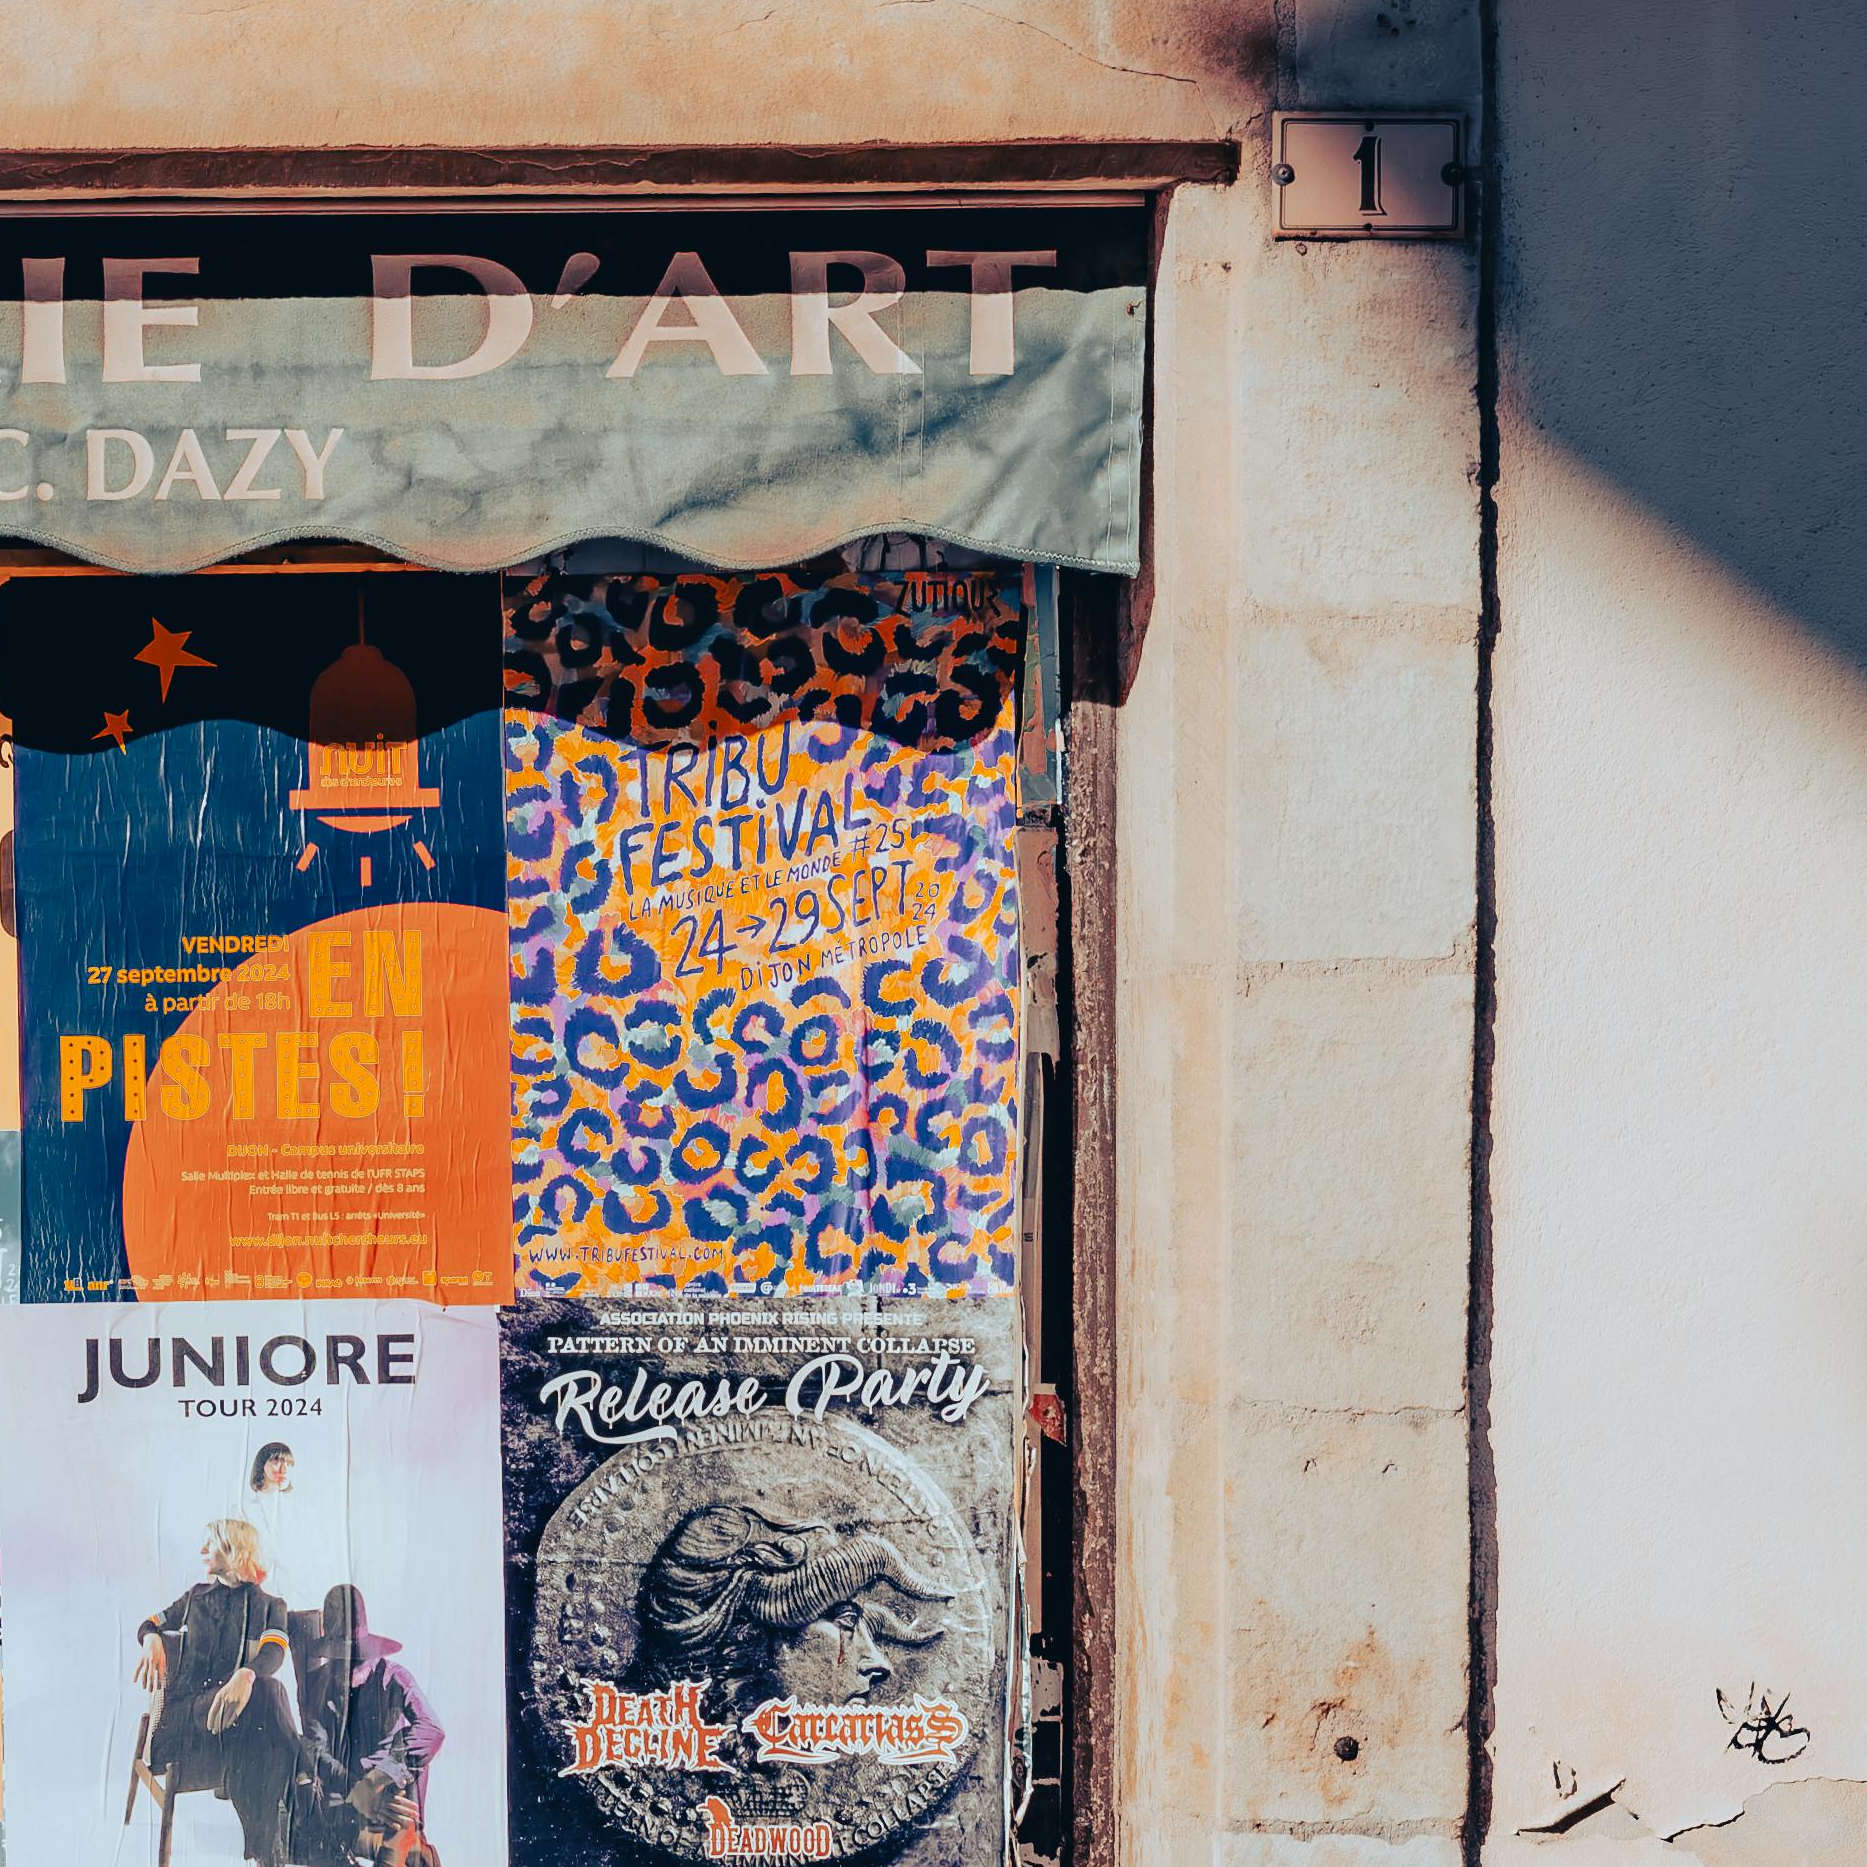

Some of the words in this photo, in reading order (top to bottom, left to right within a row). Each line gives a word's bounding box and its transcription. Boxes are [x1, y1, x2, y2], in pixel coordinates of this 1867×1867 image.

[1354, 135, 1386, 217] 1
[370, 249, 1057, 382] D'ART
[87, 427, 344, 501] DAZY
[848, 818, 906, 862] #25
[629, 898, 652, 921] LA
[740, 872, 762, 896] ET
[765, 869, 784, 890] LE
[786, 851, 842, 887] MONDE
[670, 909, 735, 978] 24
[768, 890, 821, 953] 29
[827, 859, 914, 934] SEPT
[181, 935, 290, 954] VENDREDI
[821, 924, 927, 966] MÉTROPOLE
[87, 966, 113, 985] 27
[117, 964, 231, 987] septembre
[237, 964, 291, 982] 2024
[308, 929, 423, 1018] EN
[145, 993, 158, 1012] à
[162, 992, 220, 1014] partir
[224, 991, 251, 1011] de
[255, 992, 291, 1011] 18h
[600, 1312, 704, 1327] ASSOCIATION
[708, 1312, 778, 1327] PHOENIX
[783, 1312, 837, 1327] RISING
[842, 1312, 924, 1327] PRESENTE
[547, 1336, 651, 1354] PATTERN
[657, 1336, 686, 1354] OF
[692, 1336, 730, 1354] AN
[734, 1336, 851, 1354] IMMINENT
[857, 1337, 975, 1355] COLLAPSE
[77, 1333, 417, 1404] JUNIORE
[178, 1399, 258, 1418] TOUR
[267, 1397, 323, 1417] 2024
[540, 1366, 768, 1444] Release
[786, 1350, 992, 1423] Party
[708, 1821, 833, 1859] DEADWOOD
